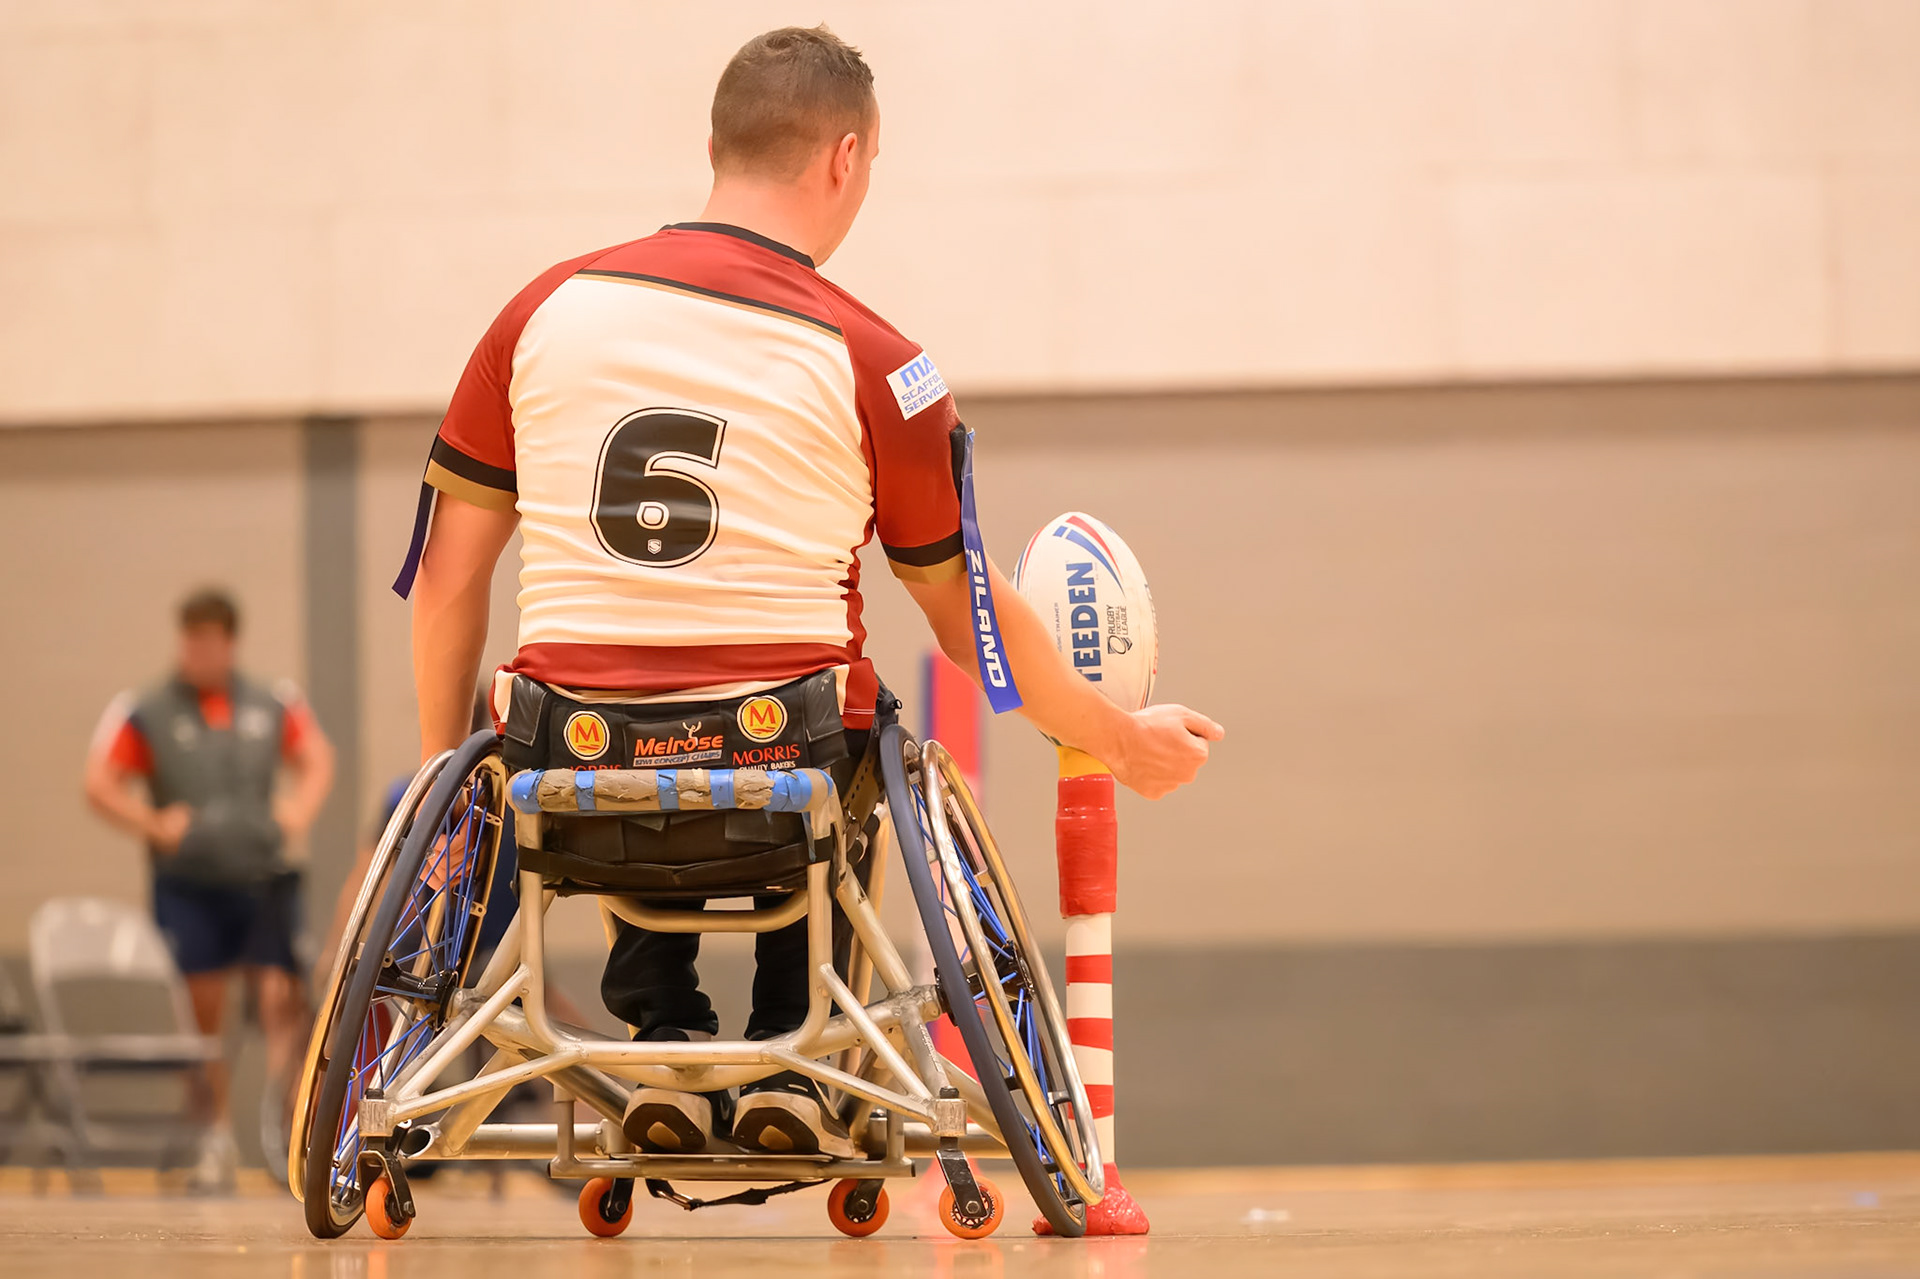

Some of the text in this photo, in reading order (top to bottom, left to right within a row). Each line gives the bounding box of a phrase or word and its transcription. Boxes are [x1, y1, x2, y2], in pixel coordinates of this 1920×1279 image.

[589, 407, 727, 568] 6
[970, 549, 1007, 688] ZILAND
[1106, 604, 1116, 634] RUGBY
[1120, 605, 1128, 635] LEAGUE
[635, 735, 724, 756] Melrose
[732, 743, 801, 766] MORRIS
